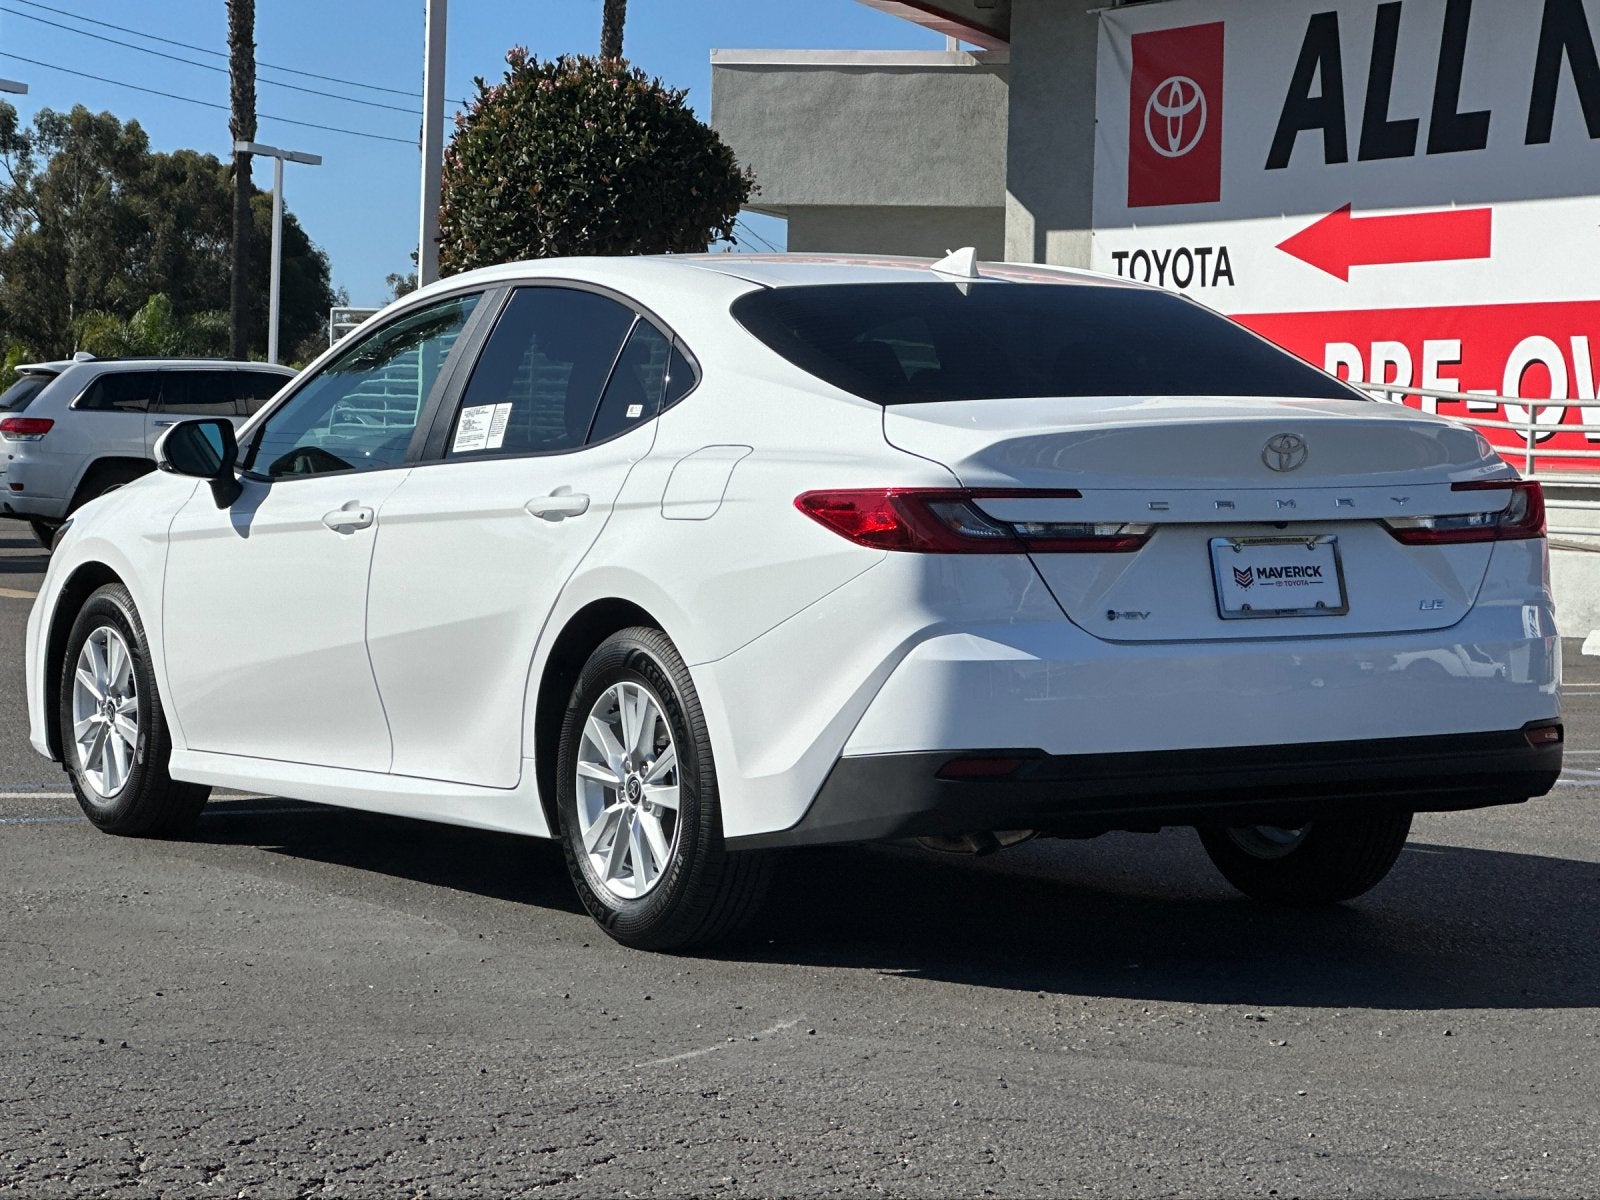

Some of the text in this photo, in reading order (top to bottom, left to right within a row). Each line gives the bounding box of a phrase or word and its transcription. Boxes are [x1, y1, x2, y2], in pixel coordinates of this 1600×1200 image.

[1265, 0, 1492, 170] ALL
[1111, 246, 1235, 289] TOYOTA
[1147, 497, 1411, 511] CAMRY
[1256, 565, 1323, 580] MAVERICK
[1418, 599, 1445, 611] LE
